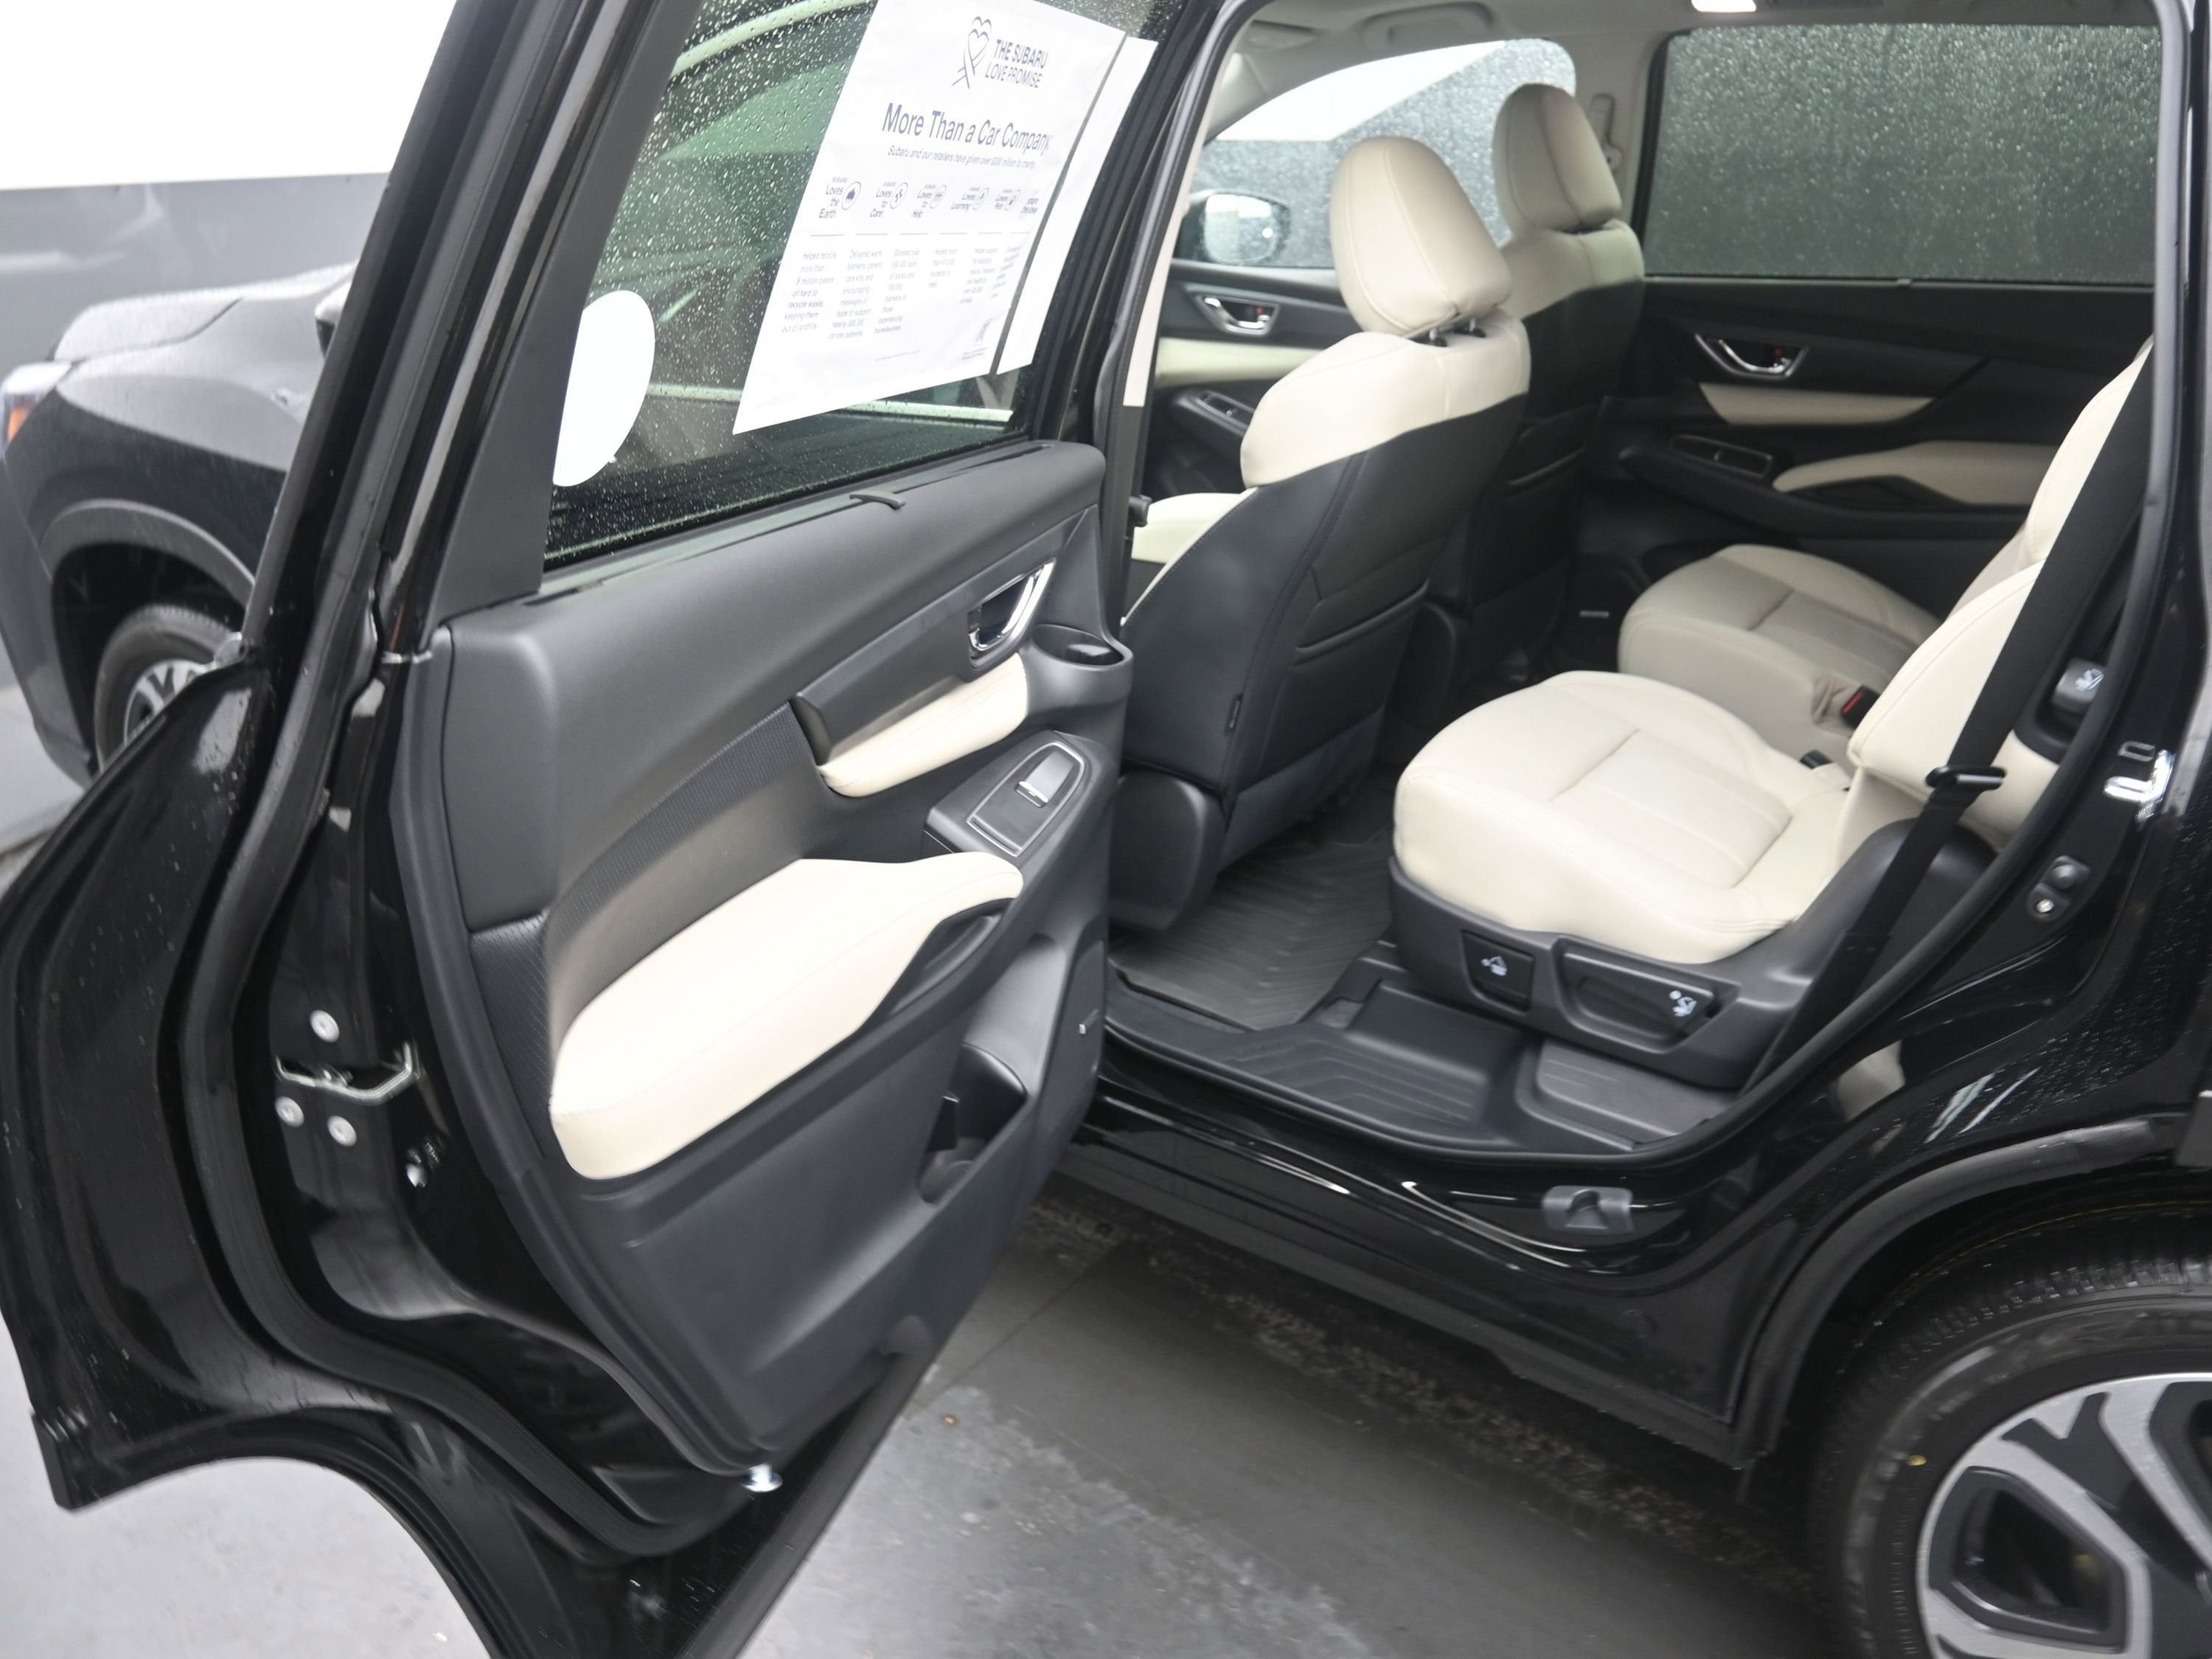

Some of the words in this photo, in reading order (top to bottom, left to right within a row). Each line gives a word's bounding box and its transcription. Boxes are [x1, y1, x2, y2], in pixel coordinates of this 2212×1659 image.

[994, 39, 1013, 60] THE
[1012, 44, 1049, 69] SUBARU
[985, 62, 1009, 81] LOVE
[1006, 66, 1043, 88] PROMISE
[882, 102, 925, 136] More
[929, 110, 964, 142] Than
[964, 124, 976, 144] a
[978, 119, 1001, 146] Car
[887, 145, 910, 158] Subaru
[909, 150, 922, 159] and
[922, 151, 933, 159] our
[933, 150, 955, 161] retailers
[825, 184, 844, 195] Loves
[875, 189, 892, 198] Loves
[917, 190, 933, 199] Loves
[961, 192, 975, 201] Loves
[830, 197, 840, 207] the
[881, 200, 888, 208] to
[818, 208, 836, 219] Earth
[869, 208, 883, 218] Care
